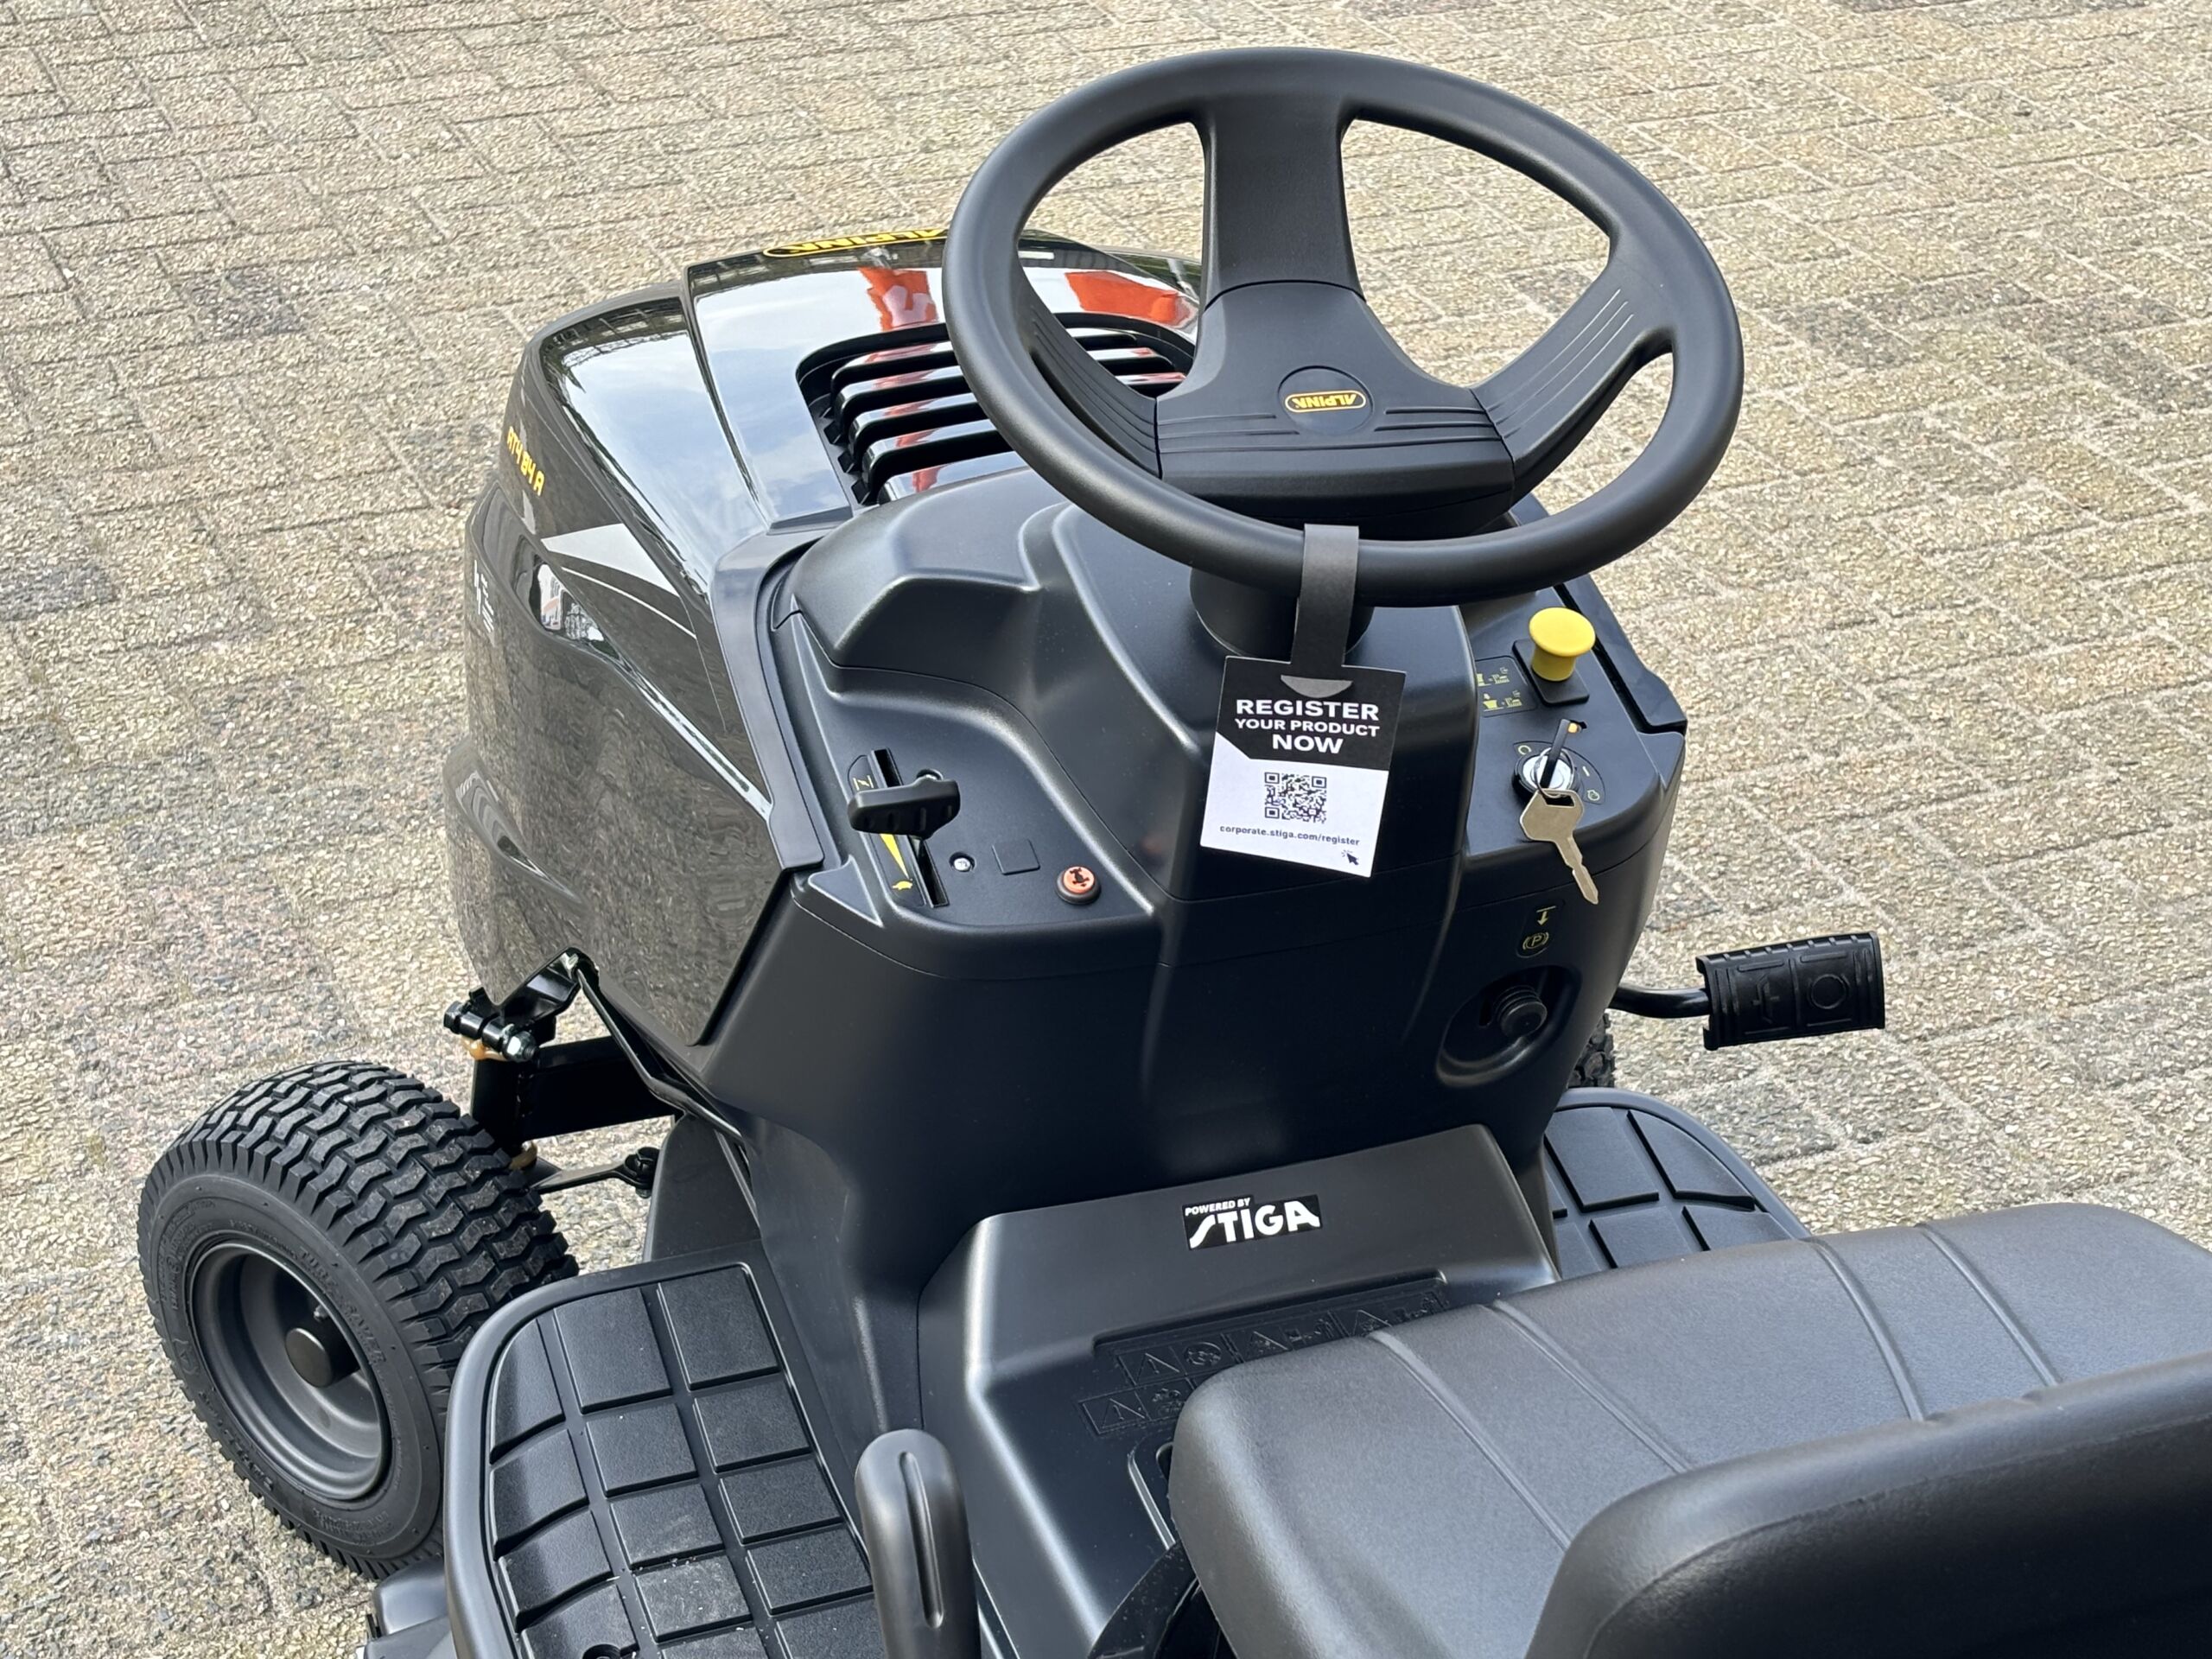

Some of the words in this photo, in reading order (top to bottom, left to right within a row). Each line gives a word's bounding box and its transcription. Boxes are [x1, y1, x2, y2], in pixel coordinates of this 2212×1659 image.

[1293, 394, 1357, 409] ALPINA
[507, 426, 523, 464] AT4
[533, 470, 544, 496] A
[1236, 699, 1379, 721] REGISTER
[1235, 718, 1286, 730] YOUR
[1290, 720, 1380, 737] PRODUCT
[1272, 734, 1344, 753] NOW
[1219, 825, 1360, 846] corporate.stiga.com/register
[1185, 1200, 1236, 1217] POWERED
[1237, 1198, 1250, 1208] BY
[1189, 1200, 1320, 1249] STIGA
